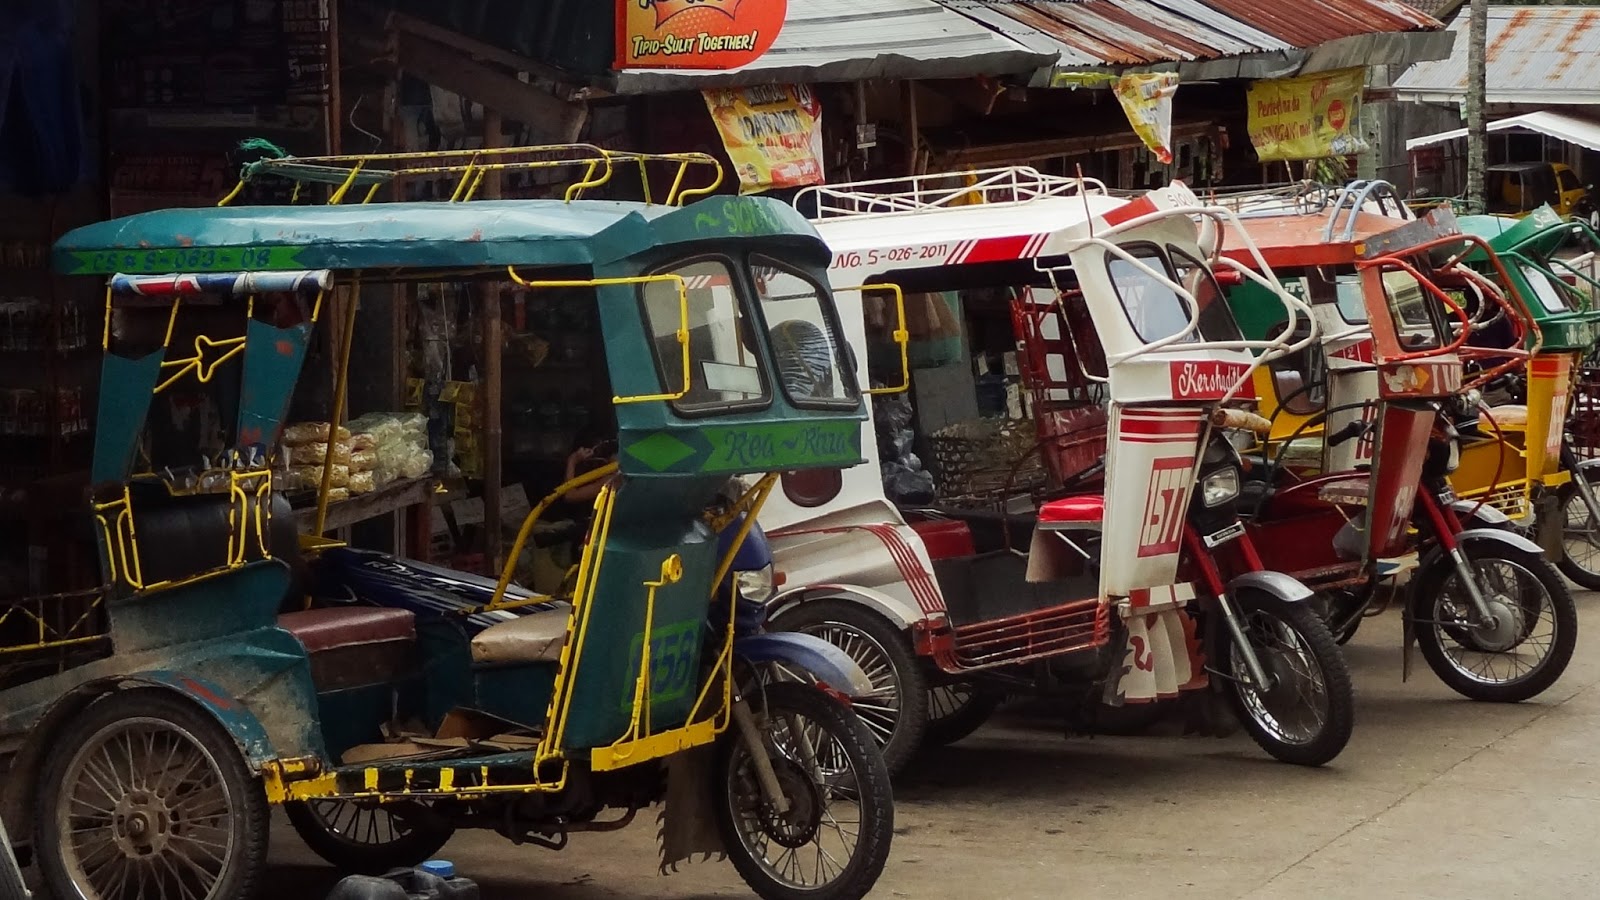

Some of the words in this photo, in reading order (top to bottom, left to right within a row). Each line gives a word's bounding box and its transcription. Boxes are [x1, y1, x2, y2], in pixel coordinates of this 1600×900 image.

[632, 34, 695, 58] TIPID-SULIT
[698, 30, 758, 54] TOGETHER!
[831, 252, 862, 269] No.
[1141, 467, 1192, 547] 1577
